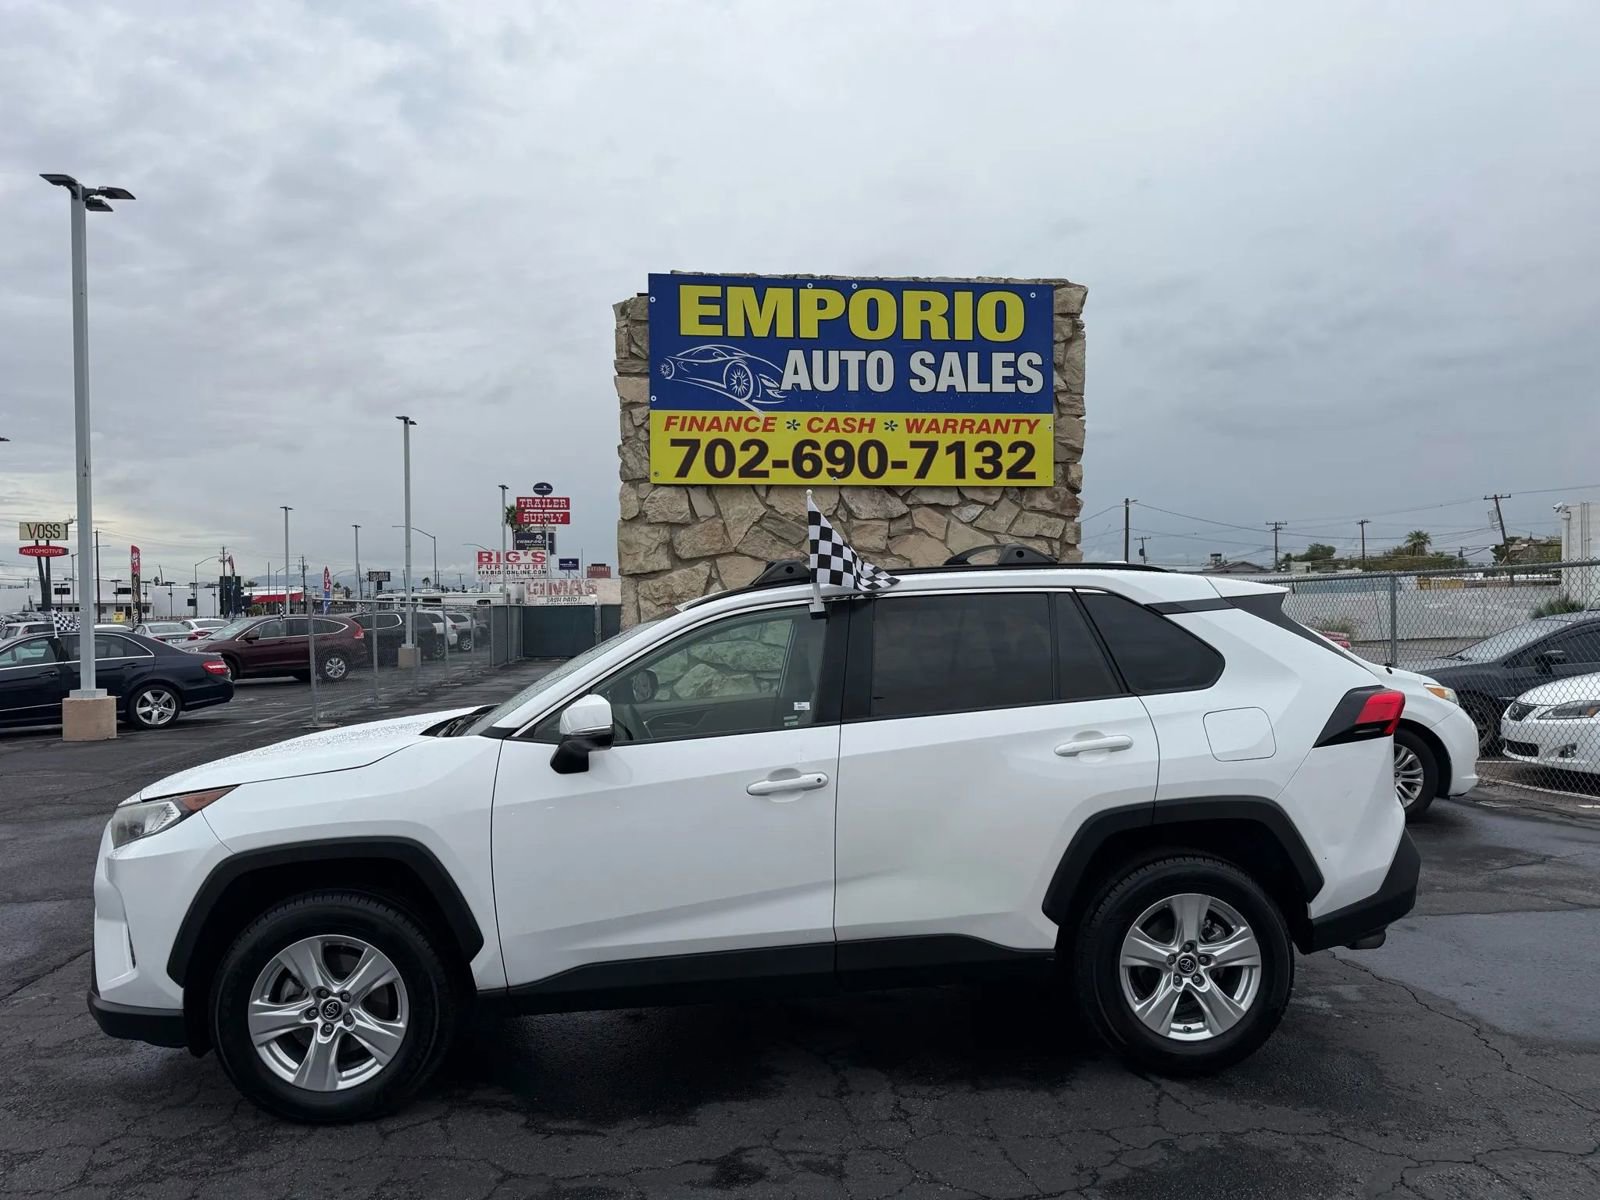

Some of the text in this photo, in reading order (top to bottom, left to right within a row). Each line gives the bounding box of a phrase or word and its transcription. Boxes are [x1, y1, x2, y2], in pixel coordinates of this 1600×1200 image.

[680, 284, 1025, 342] EMPORIO
[780, 350, 1044, 394] AUTO SALES
[663, 415, 1041, 436] FINANCE CASH WARRANTY
[670, 438, 1037, 480] 702-690-7132
[520, 499, 567, 508] TRAILER
[523, 514, 563, 522] SUPPLY
[27, 523, 60, 539] VOSS
[478, 551, 546, 563] BIG'S
